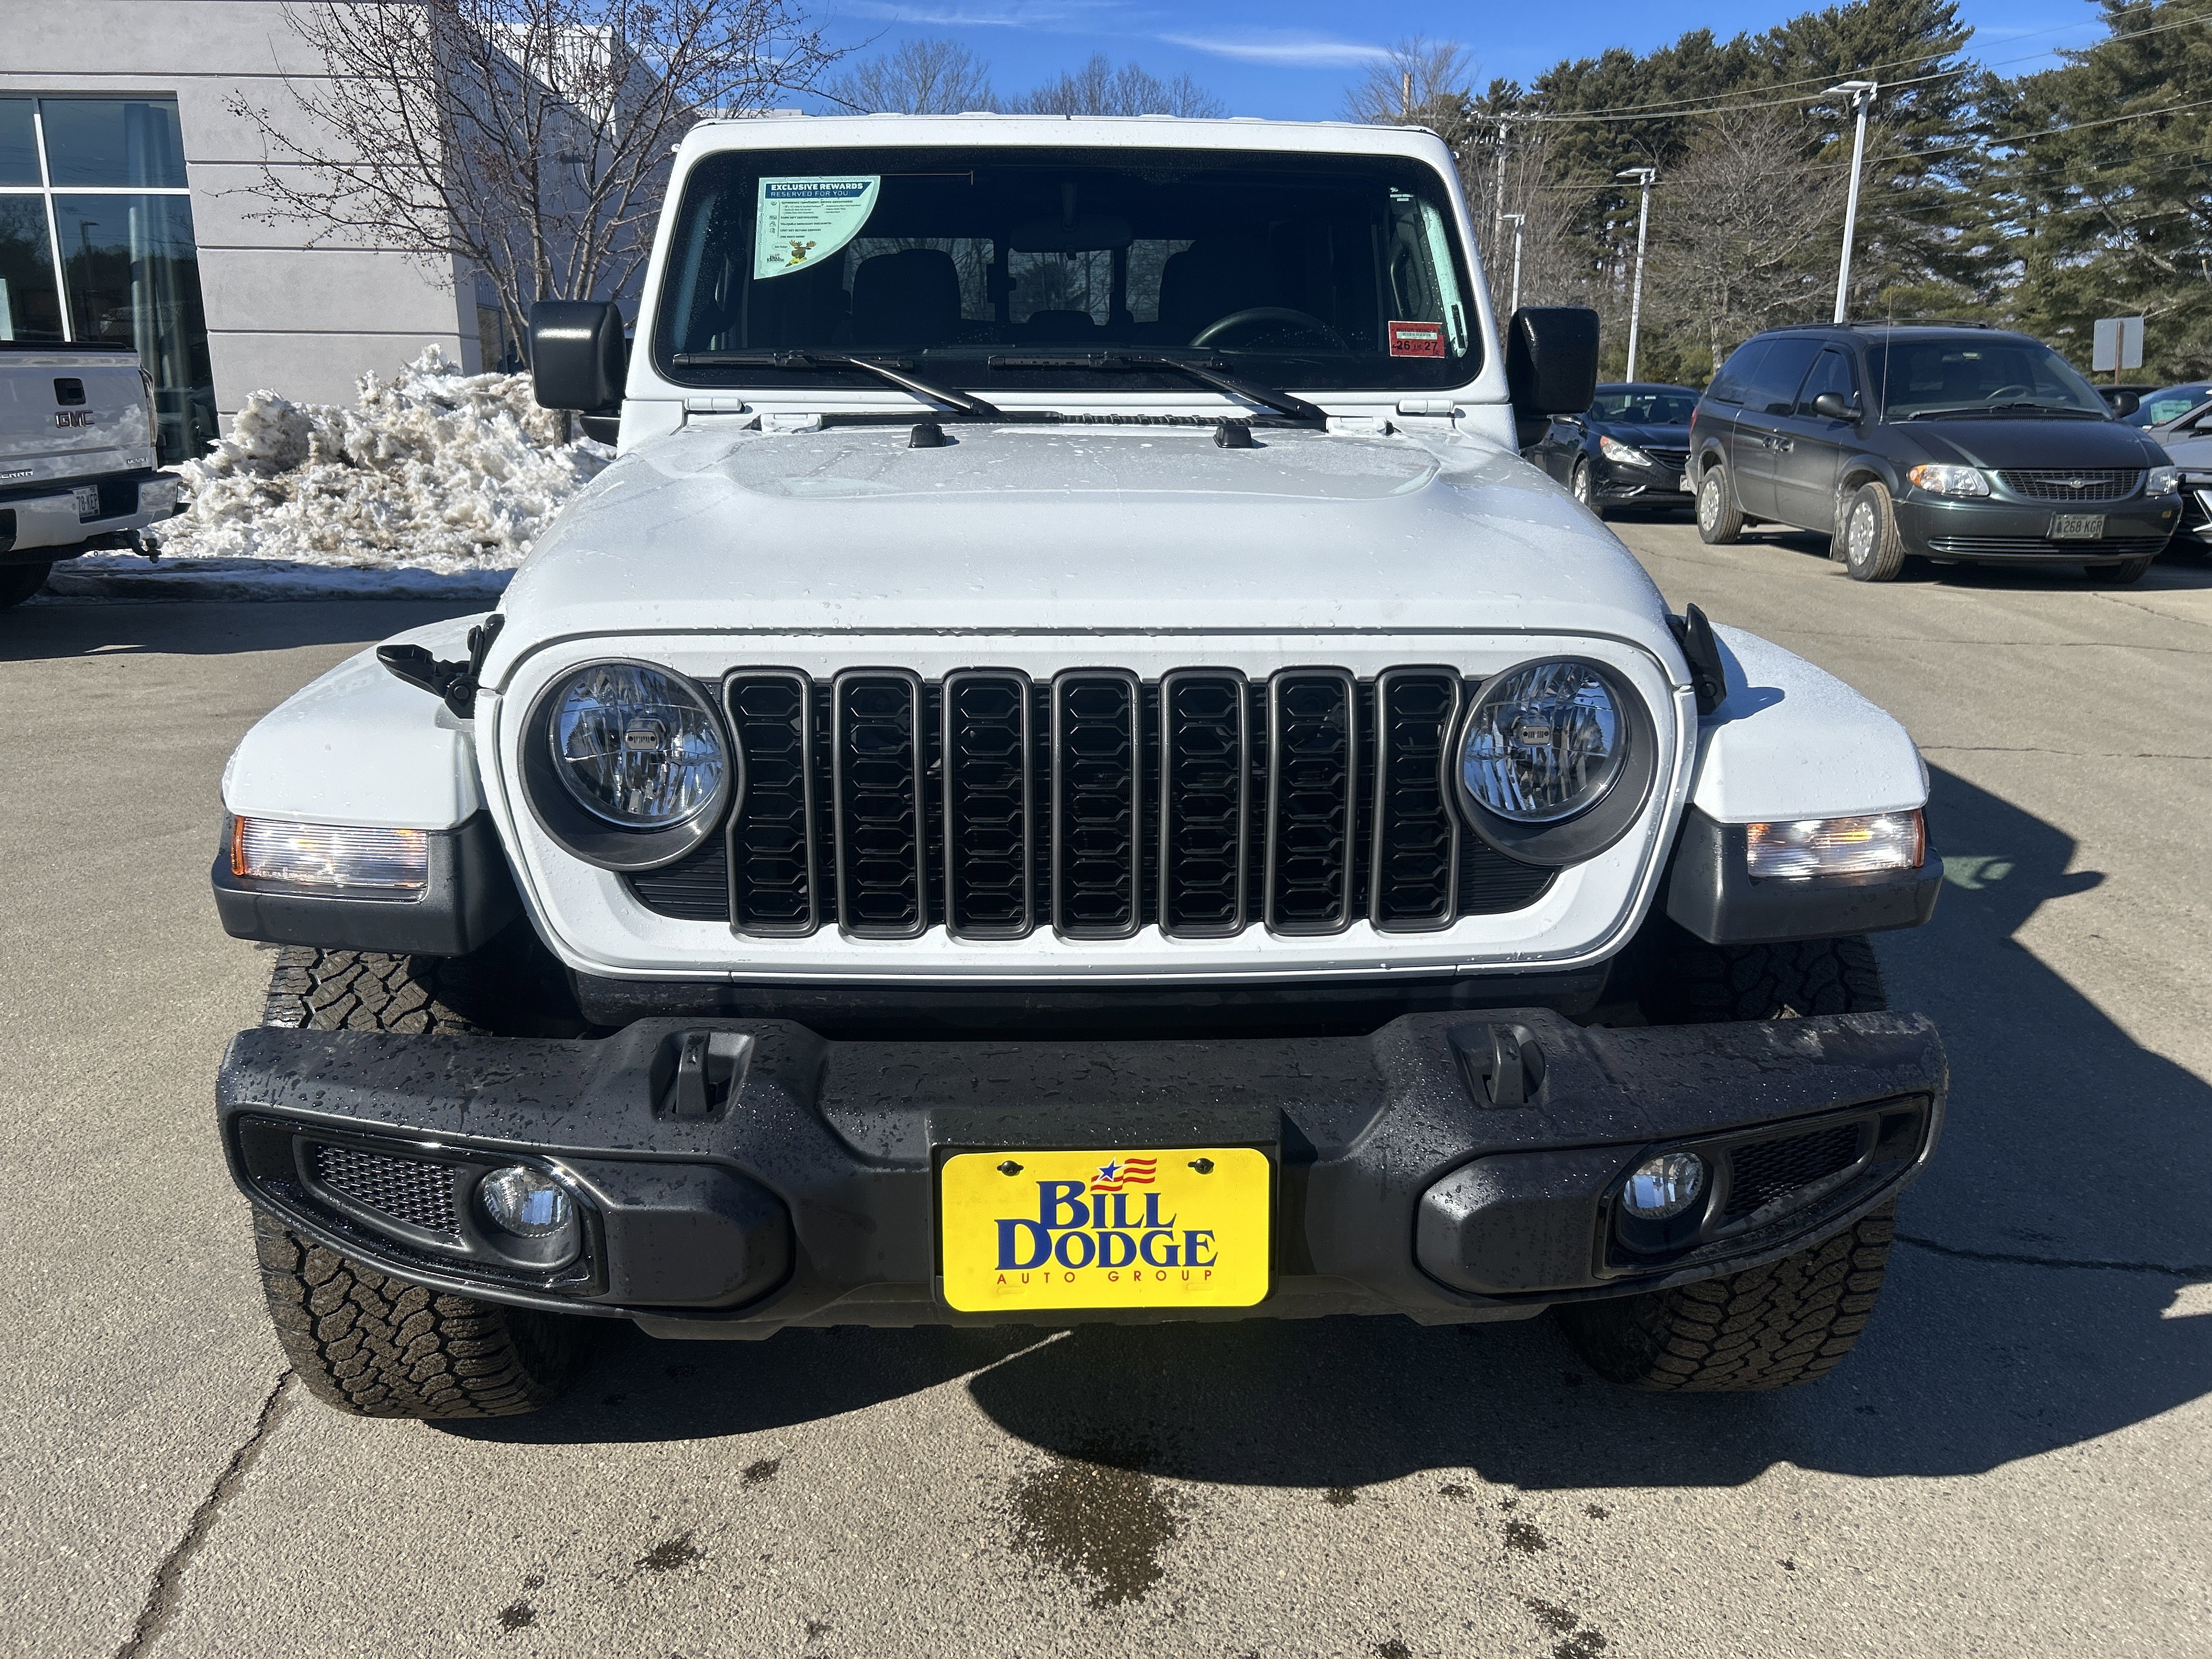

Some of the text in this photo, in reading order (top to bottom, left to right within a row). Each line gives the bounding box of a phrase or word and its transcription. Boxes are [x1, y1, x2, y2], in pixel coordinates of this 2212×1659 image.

[1396, 340, 1437, 351] 26 27
[55, 409, 95, 428] GMC
[0, 469, 33, 479] ERRA
[1036, 1181, 1176, 1230] BILL
[994, 1218, 1218, 1271] DODGE
[997, 1270, 1213, 1285] AUTO GROUP
